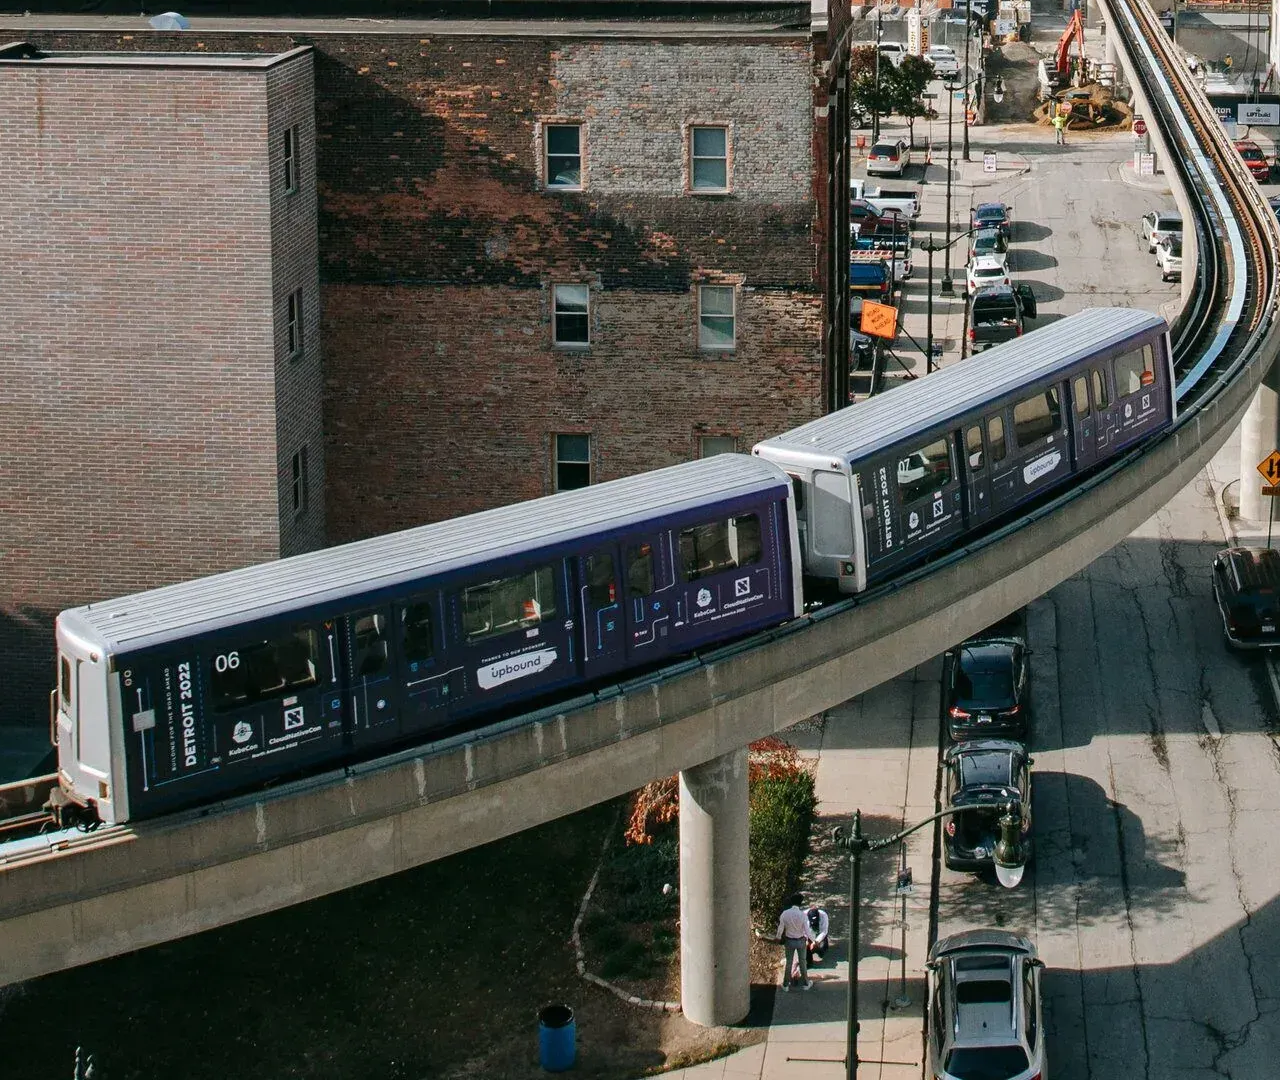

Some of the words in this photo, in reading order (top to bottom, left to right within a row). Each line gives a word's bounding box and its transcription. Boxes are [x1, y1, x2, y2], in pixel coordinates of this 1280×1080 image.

[898, 458, 910, 473] 07
[880, 467, 889, 496] 2022
[883, 499, 892, 548] DETROIT
[215, 651, 240, 673] 06
[491, 656, 541, 678] upbound
[178, 662, 193, 699] 2022
[182, 704, 197, 766] DETROIT
[269, 725, 322, 745] CloudNativeCon
[229, 743, 259, 756] KubeCon
